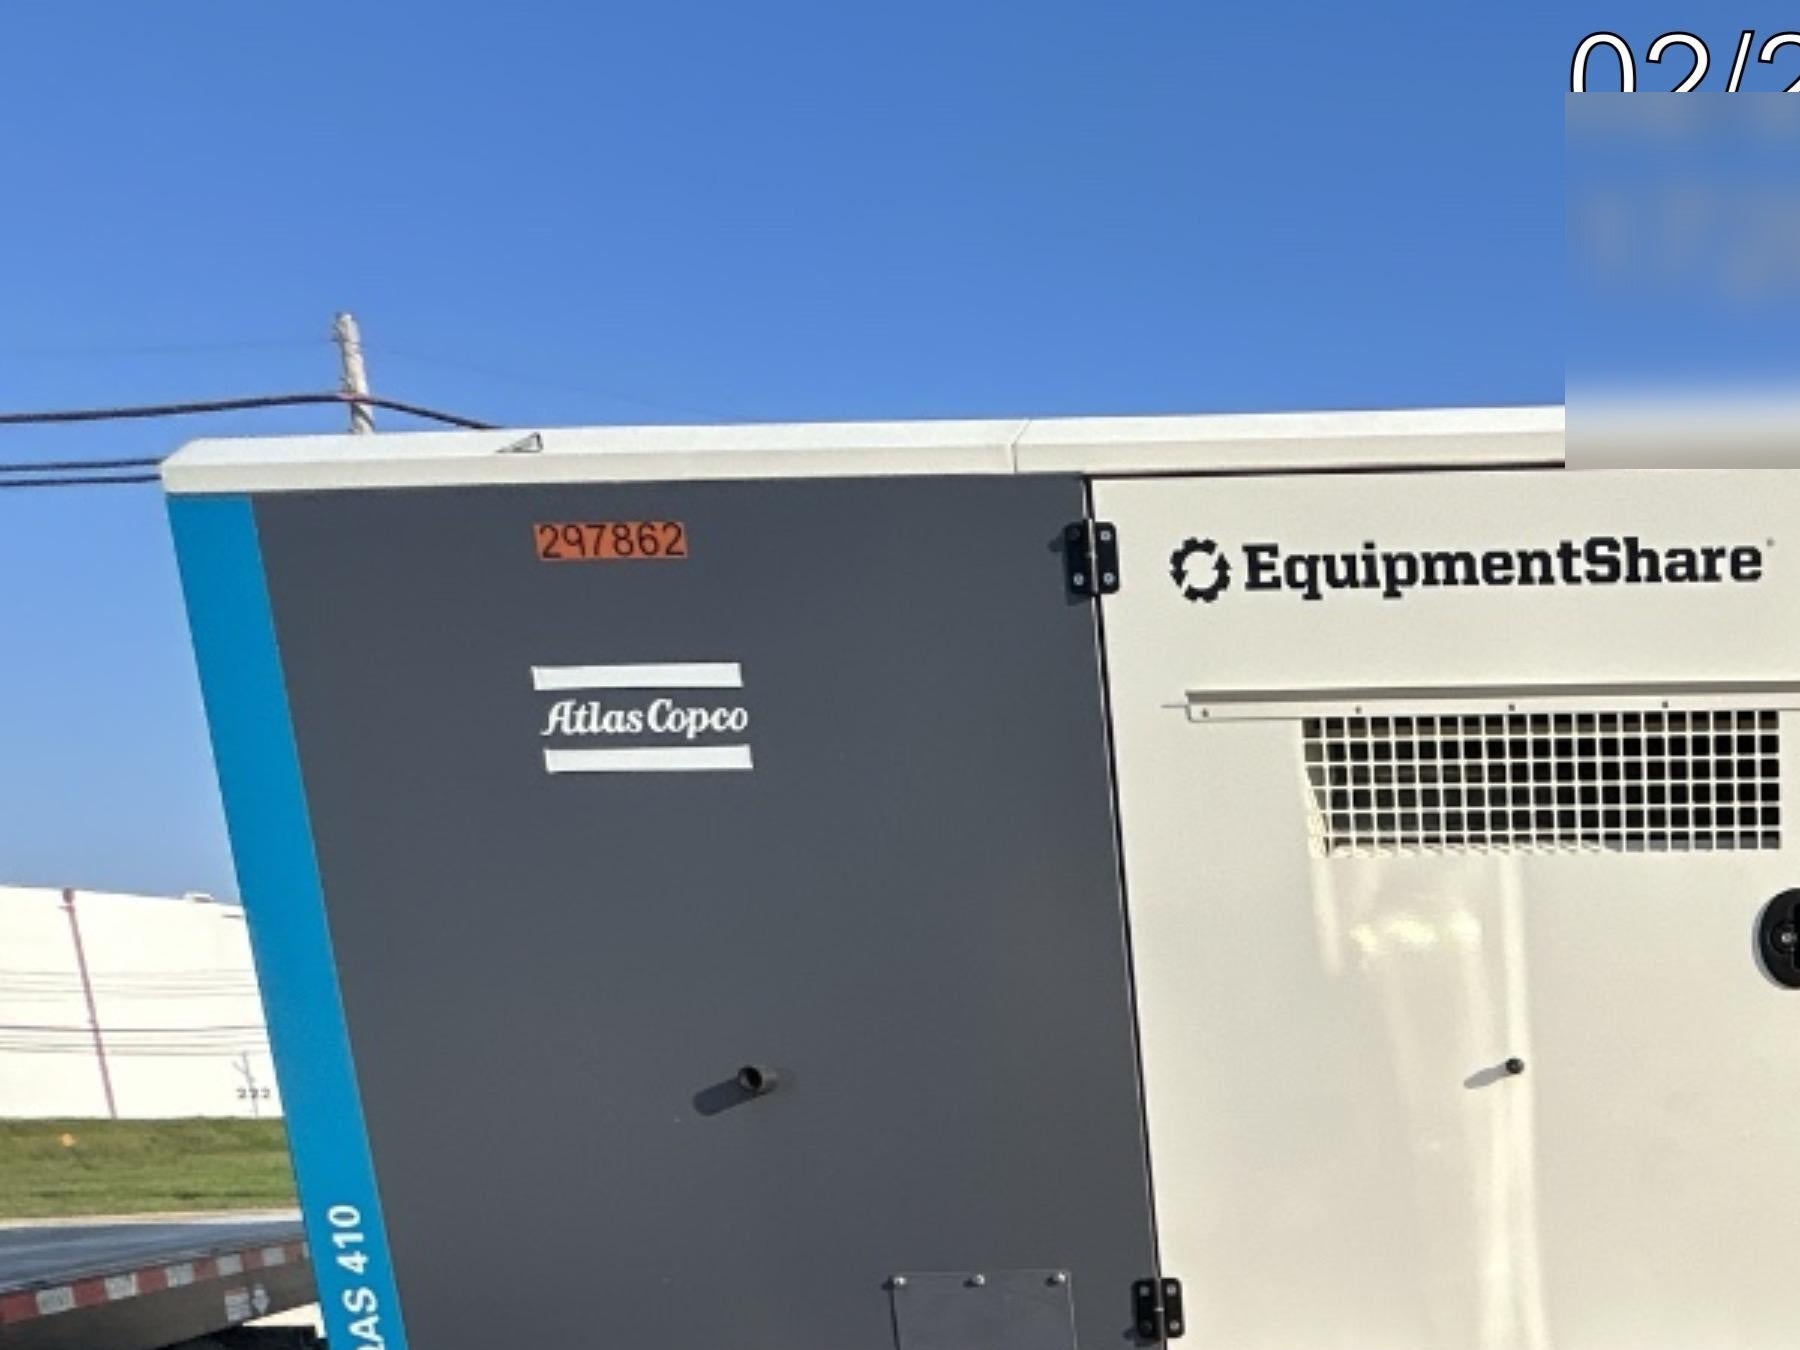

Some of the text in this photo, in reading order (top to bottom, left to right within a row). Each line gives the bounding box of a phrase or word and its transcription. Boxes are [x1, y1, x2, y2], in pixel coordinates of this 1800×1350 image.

[538, 521, 685, 558] 297862
[1242, 536, 1763, 601] EquipmentShare
[540, 698, 749, 740] Atlas Copco
[327, 1204, 369, 1275] 410
